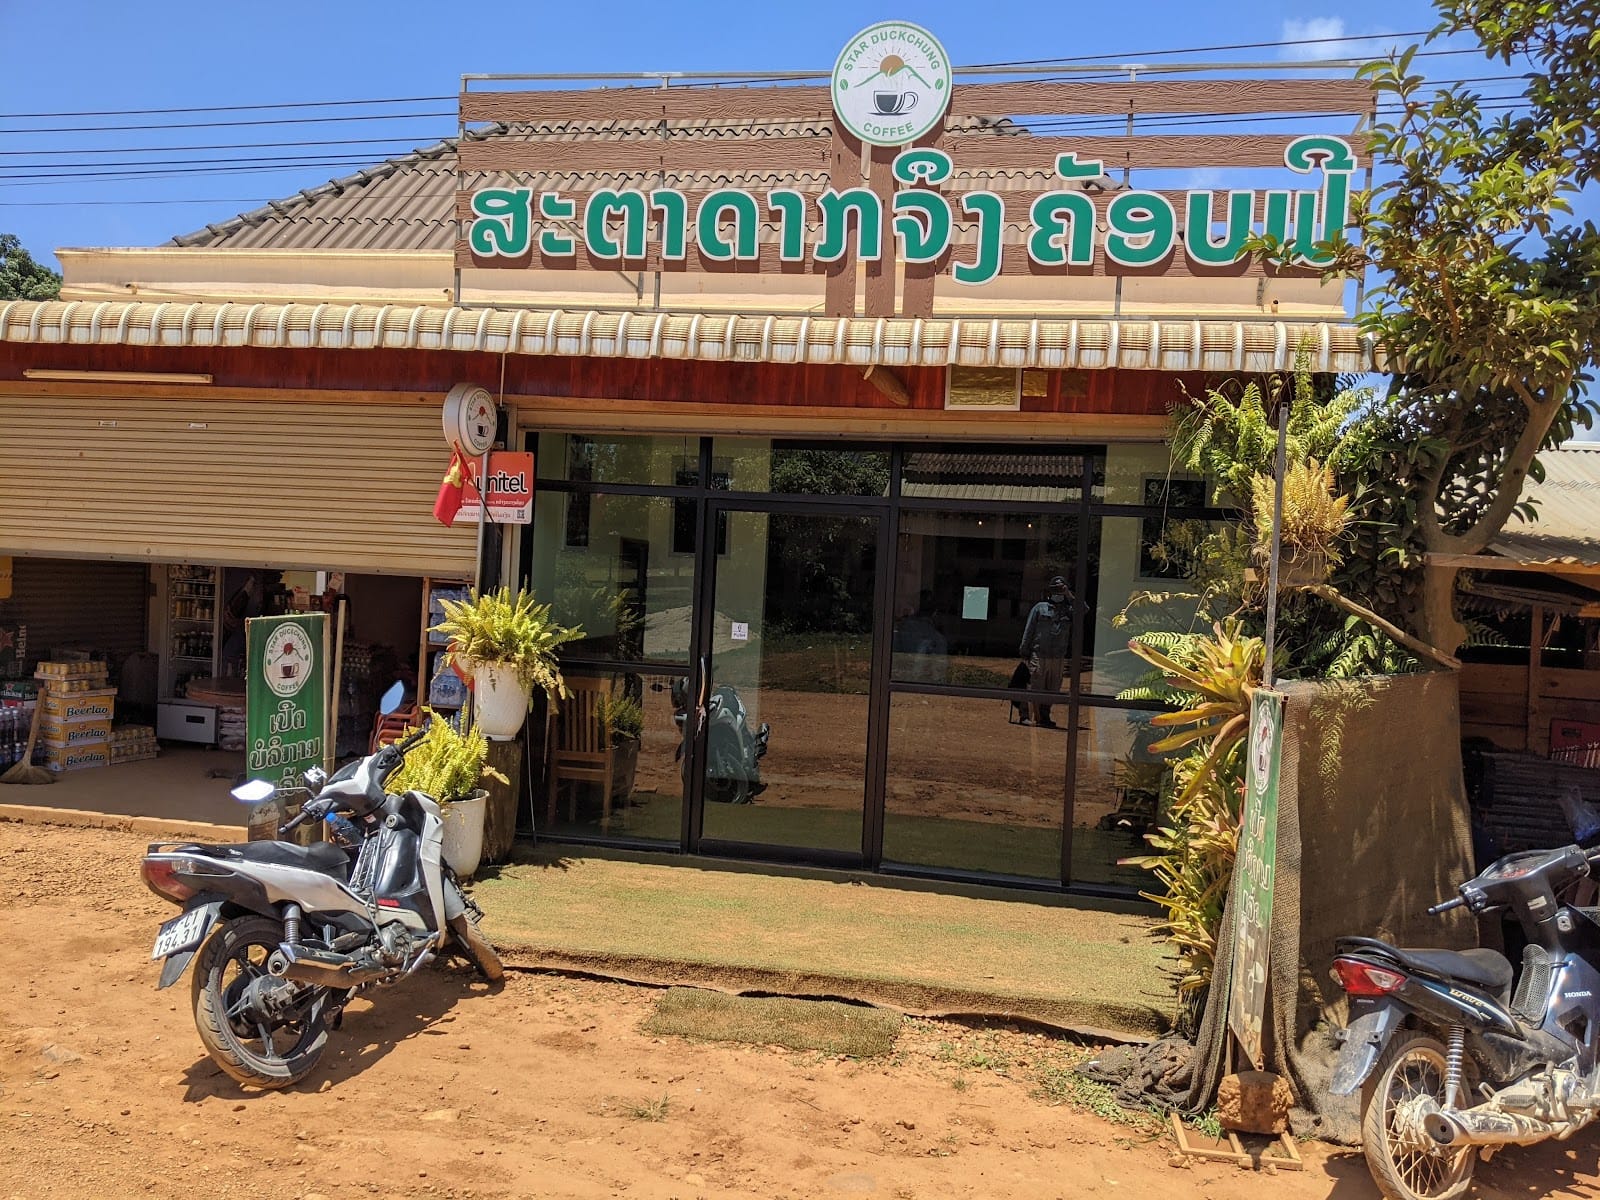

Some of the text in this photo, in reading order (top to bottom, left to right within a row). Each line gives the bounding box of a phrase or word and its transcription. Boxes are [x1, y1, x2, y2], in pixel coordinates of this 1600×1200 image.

[843, 30, 940, 72] STAR DUCKCHUNG
[863, 121, 915, 137] COFFEE
[476, 471, 528, 493] unitel
[276, 681, 299, 691] COFFEE
[66, 705, 108, 717] Beerlao
[68, 728, 106, 741] Beerlao
[66, 753, 105, 765] Beerlao
[156, 926, 197, 956] 194.31
[1564, 990, 1592, 998] HONDA
